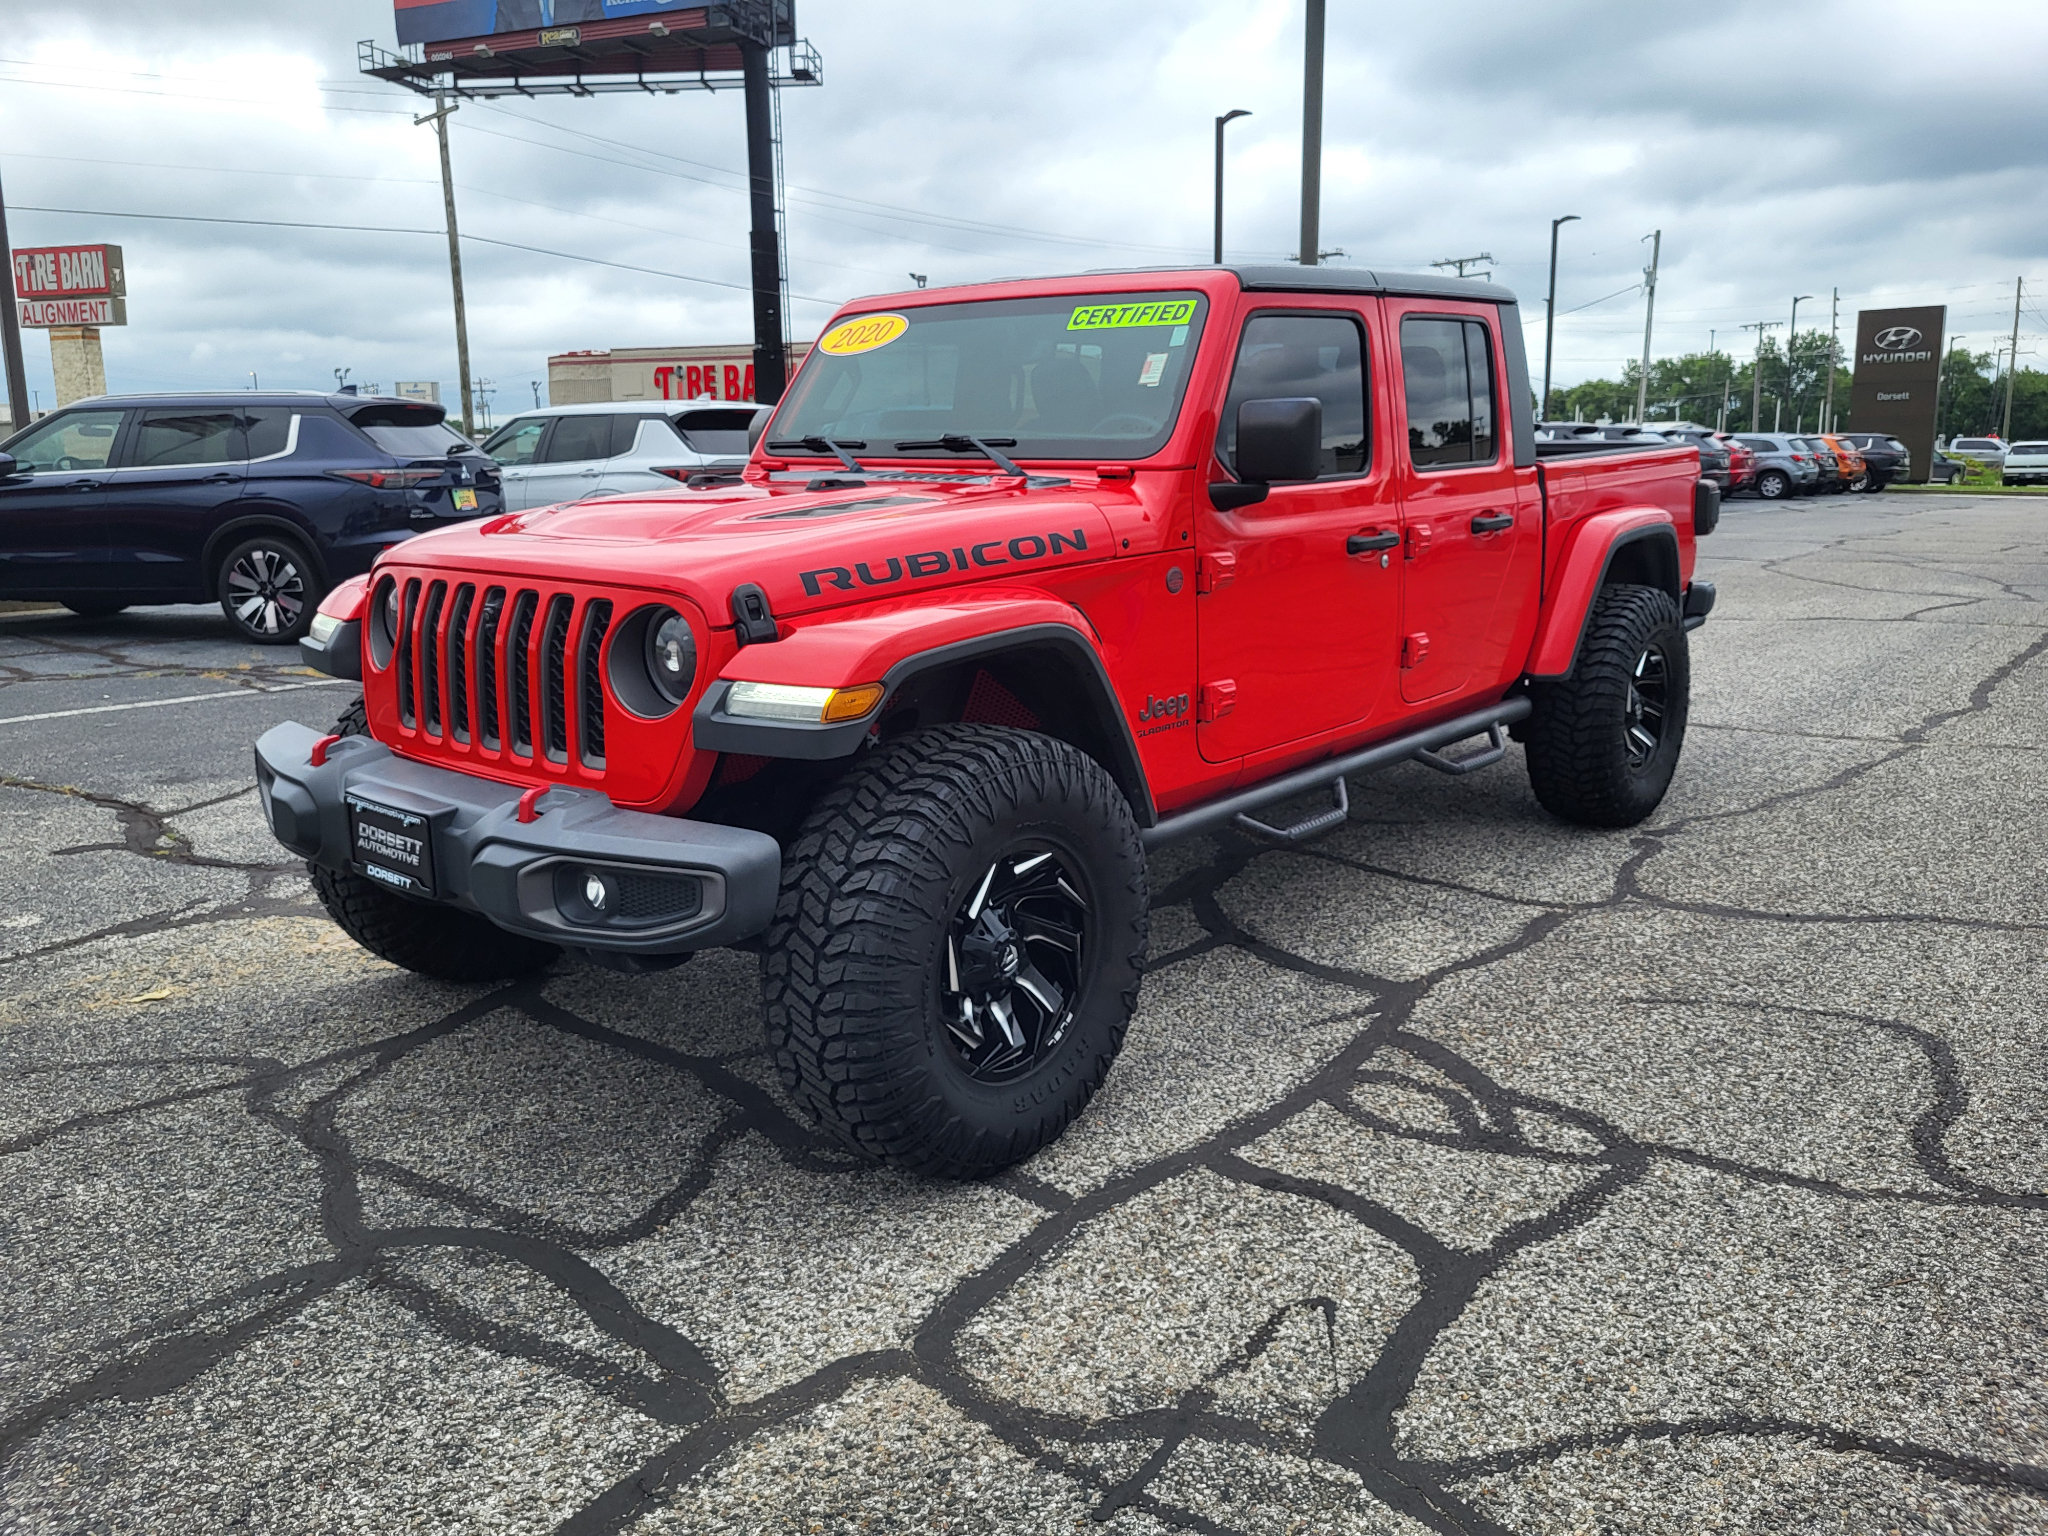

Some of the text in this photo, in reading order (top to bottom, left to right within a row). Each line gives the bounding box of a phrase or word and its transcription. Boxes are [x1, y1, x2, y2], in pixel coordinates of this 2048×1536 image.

[60, 251, 106, 289] BARN
[22, 301, 107, 325] ALIGNMENT
[1072, 304, 1190, 326] CERTIFIED
[831, 320, 894, 350] 2020
[1862, 351, 1931, 363] HYUNDAI
[1876, 391, 1909, 401] Dorsett
[799, 529, 1088, 597] RUBICON
[1139, 693, 1189, 721] Jeep
[1136, 719, 1189, 738] GLADIATOR
[358, 821, 423, 854] DORSETT
[357, 837, 420, 866] AUTOMOTIVE
[367, 864, 411, 889] DORSETT
